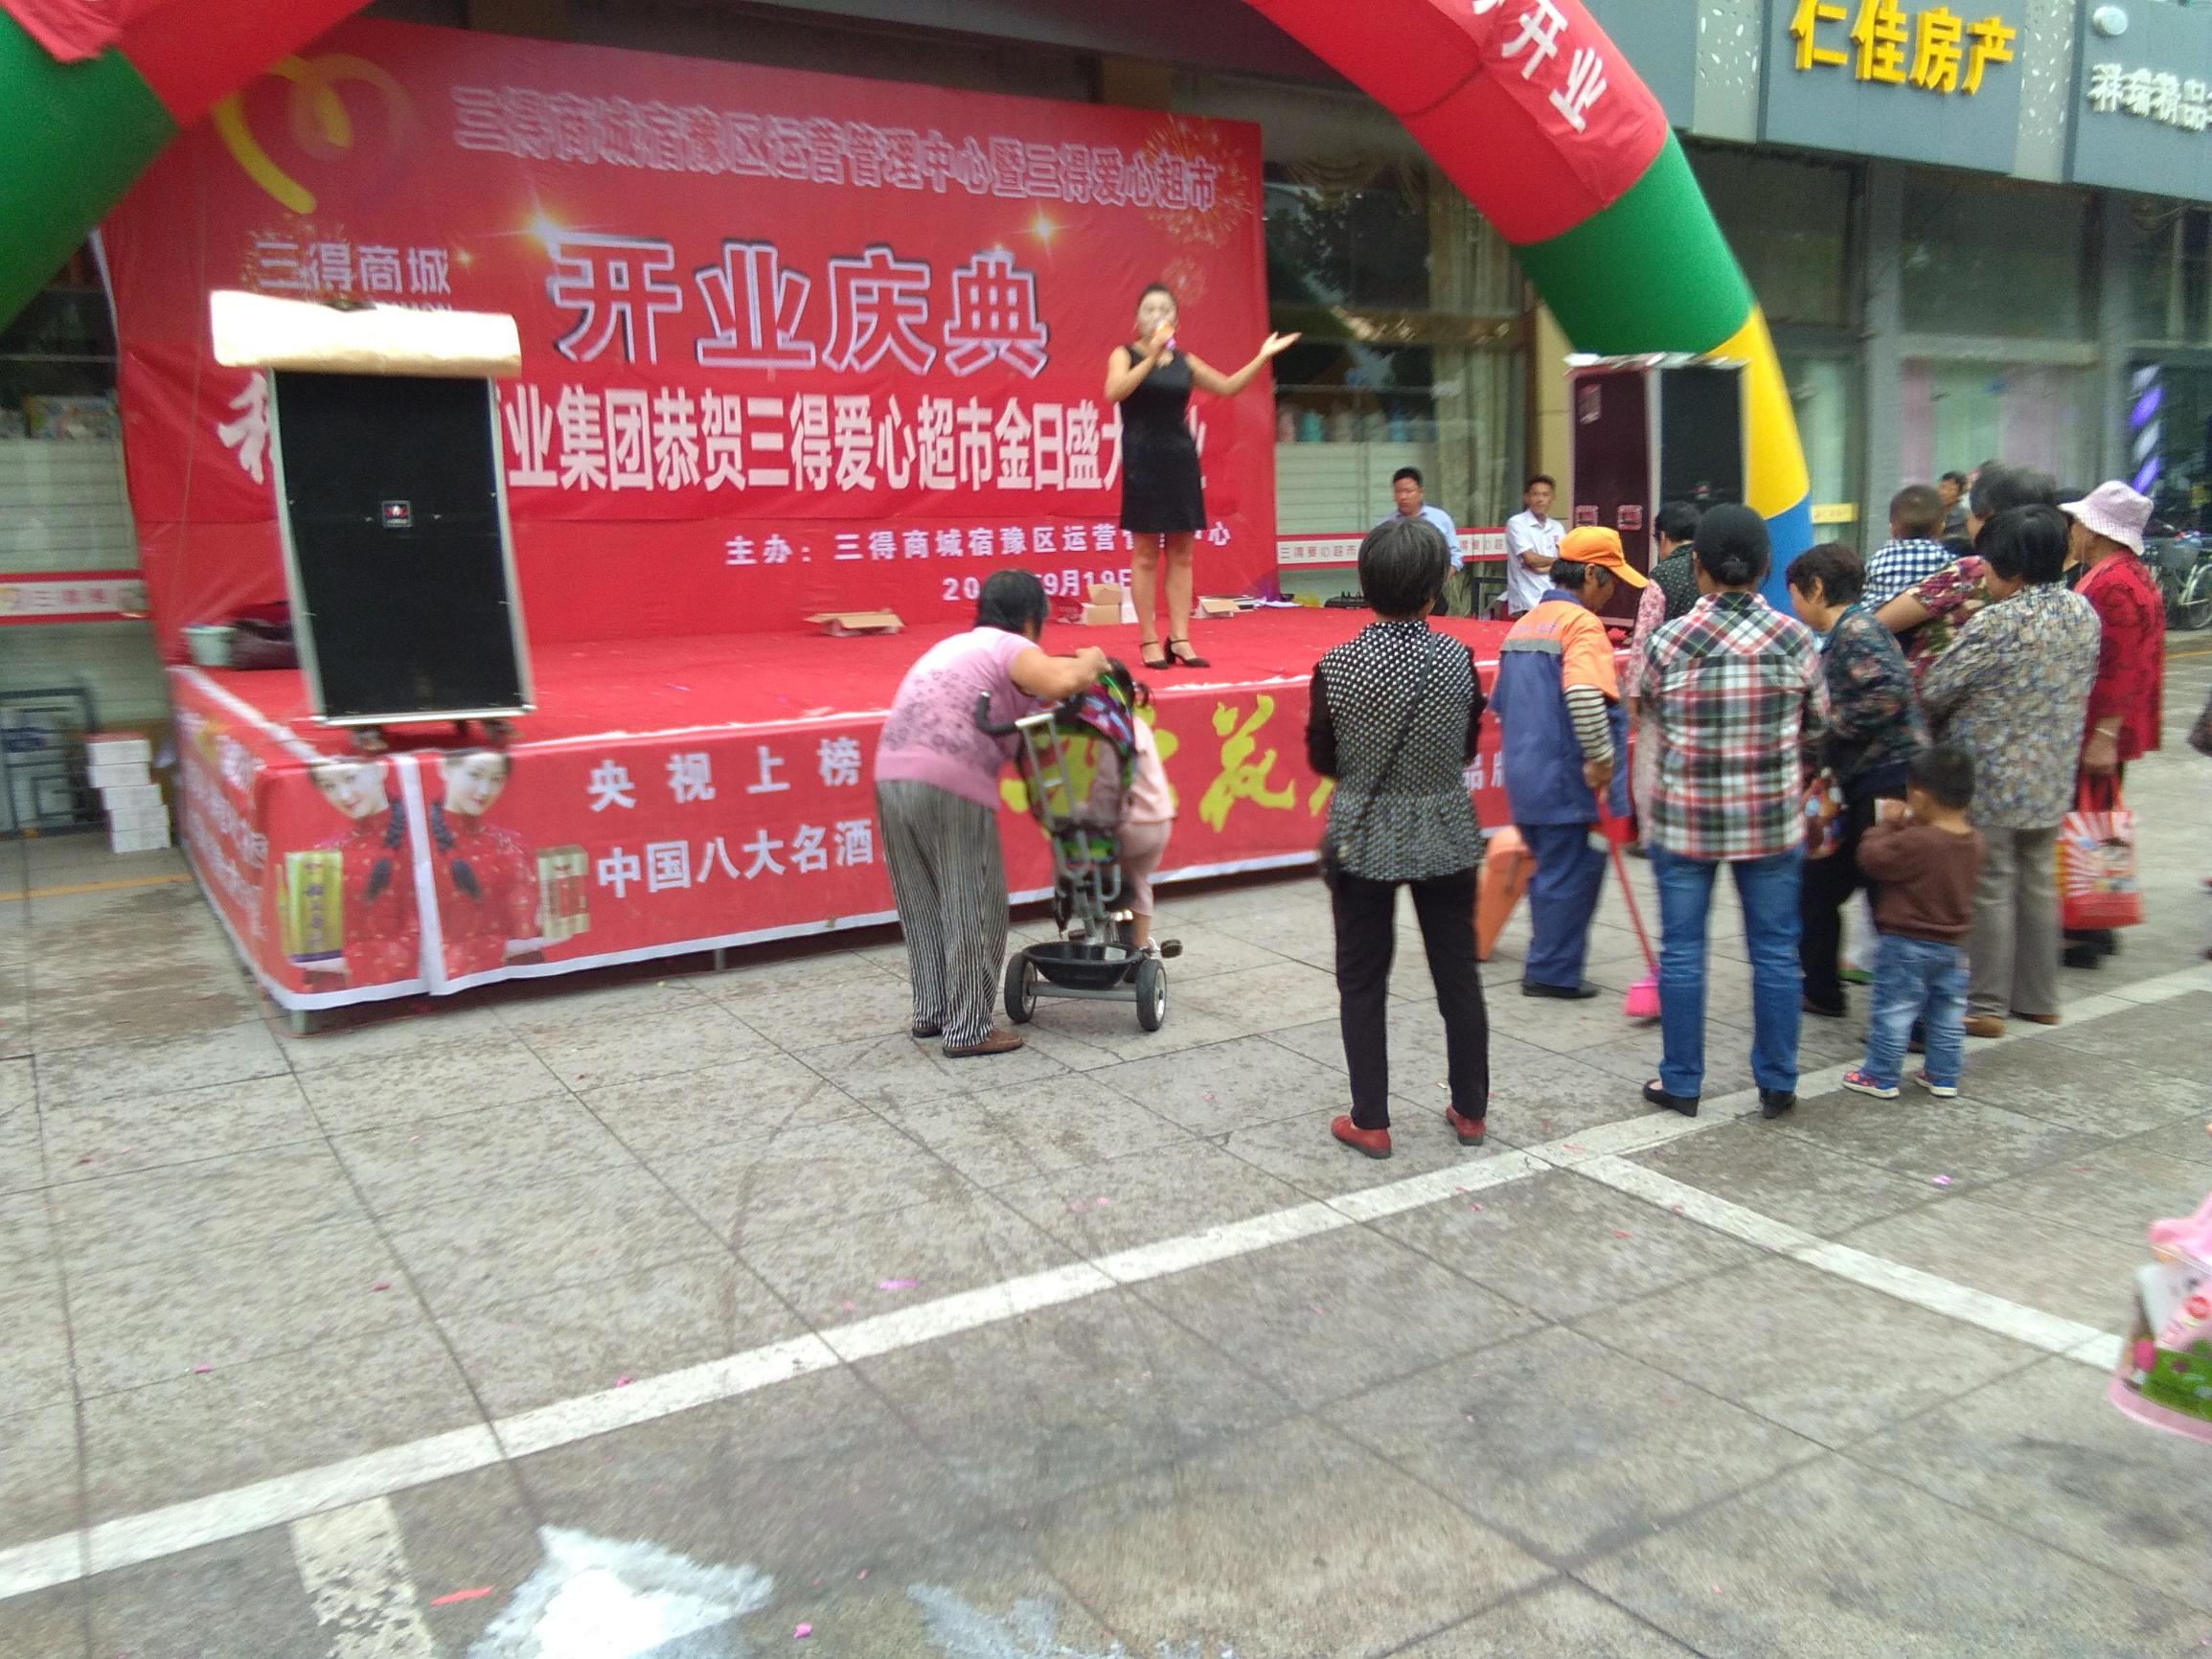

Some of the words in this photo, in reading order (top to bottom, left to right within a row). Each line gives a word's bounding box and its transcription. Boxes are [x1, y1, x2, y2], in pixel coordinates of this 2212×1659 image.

[1790, 0, 2017, 97] 仁佳房产
[255, 240, 451, 294] 三得商城
[547, 233, 1050, 379] 开业庆典
[504, 383, 1207, 492] 业集团恭贺三得爱心超市金日盛大
[725, 520, 1231, 566] 主办：三得商城宿豫区运营心
[942, 568, 1132, 602] 209月19日
[586, 736, 861, 813] 央视上榜
[597, 818, 875, 899] 中国八大名酒
